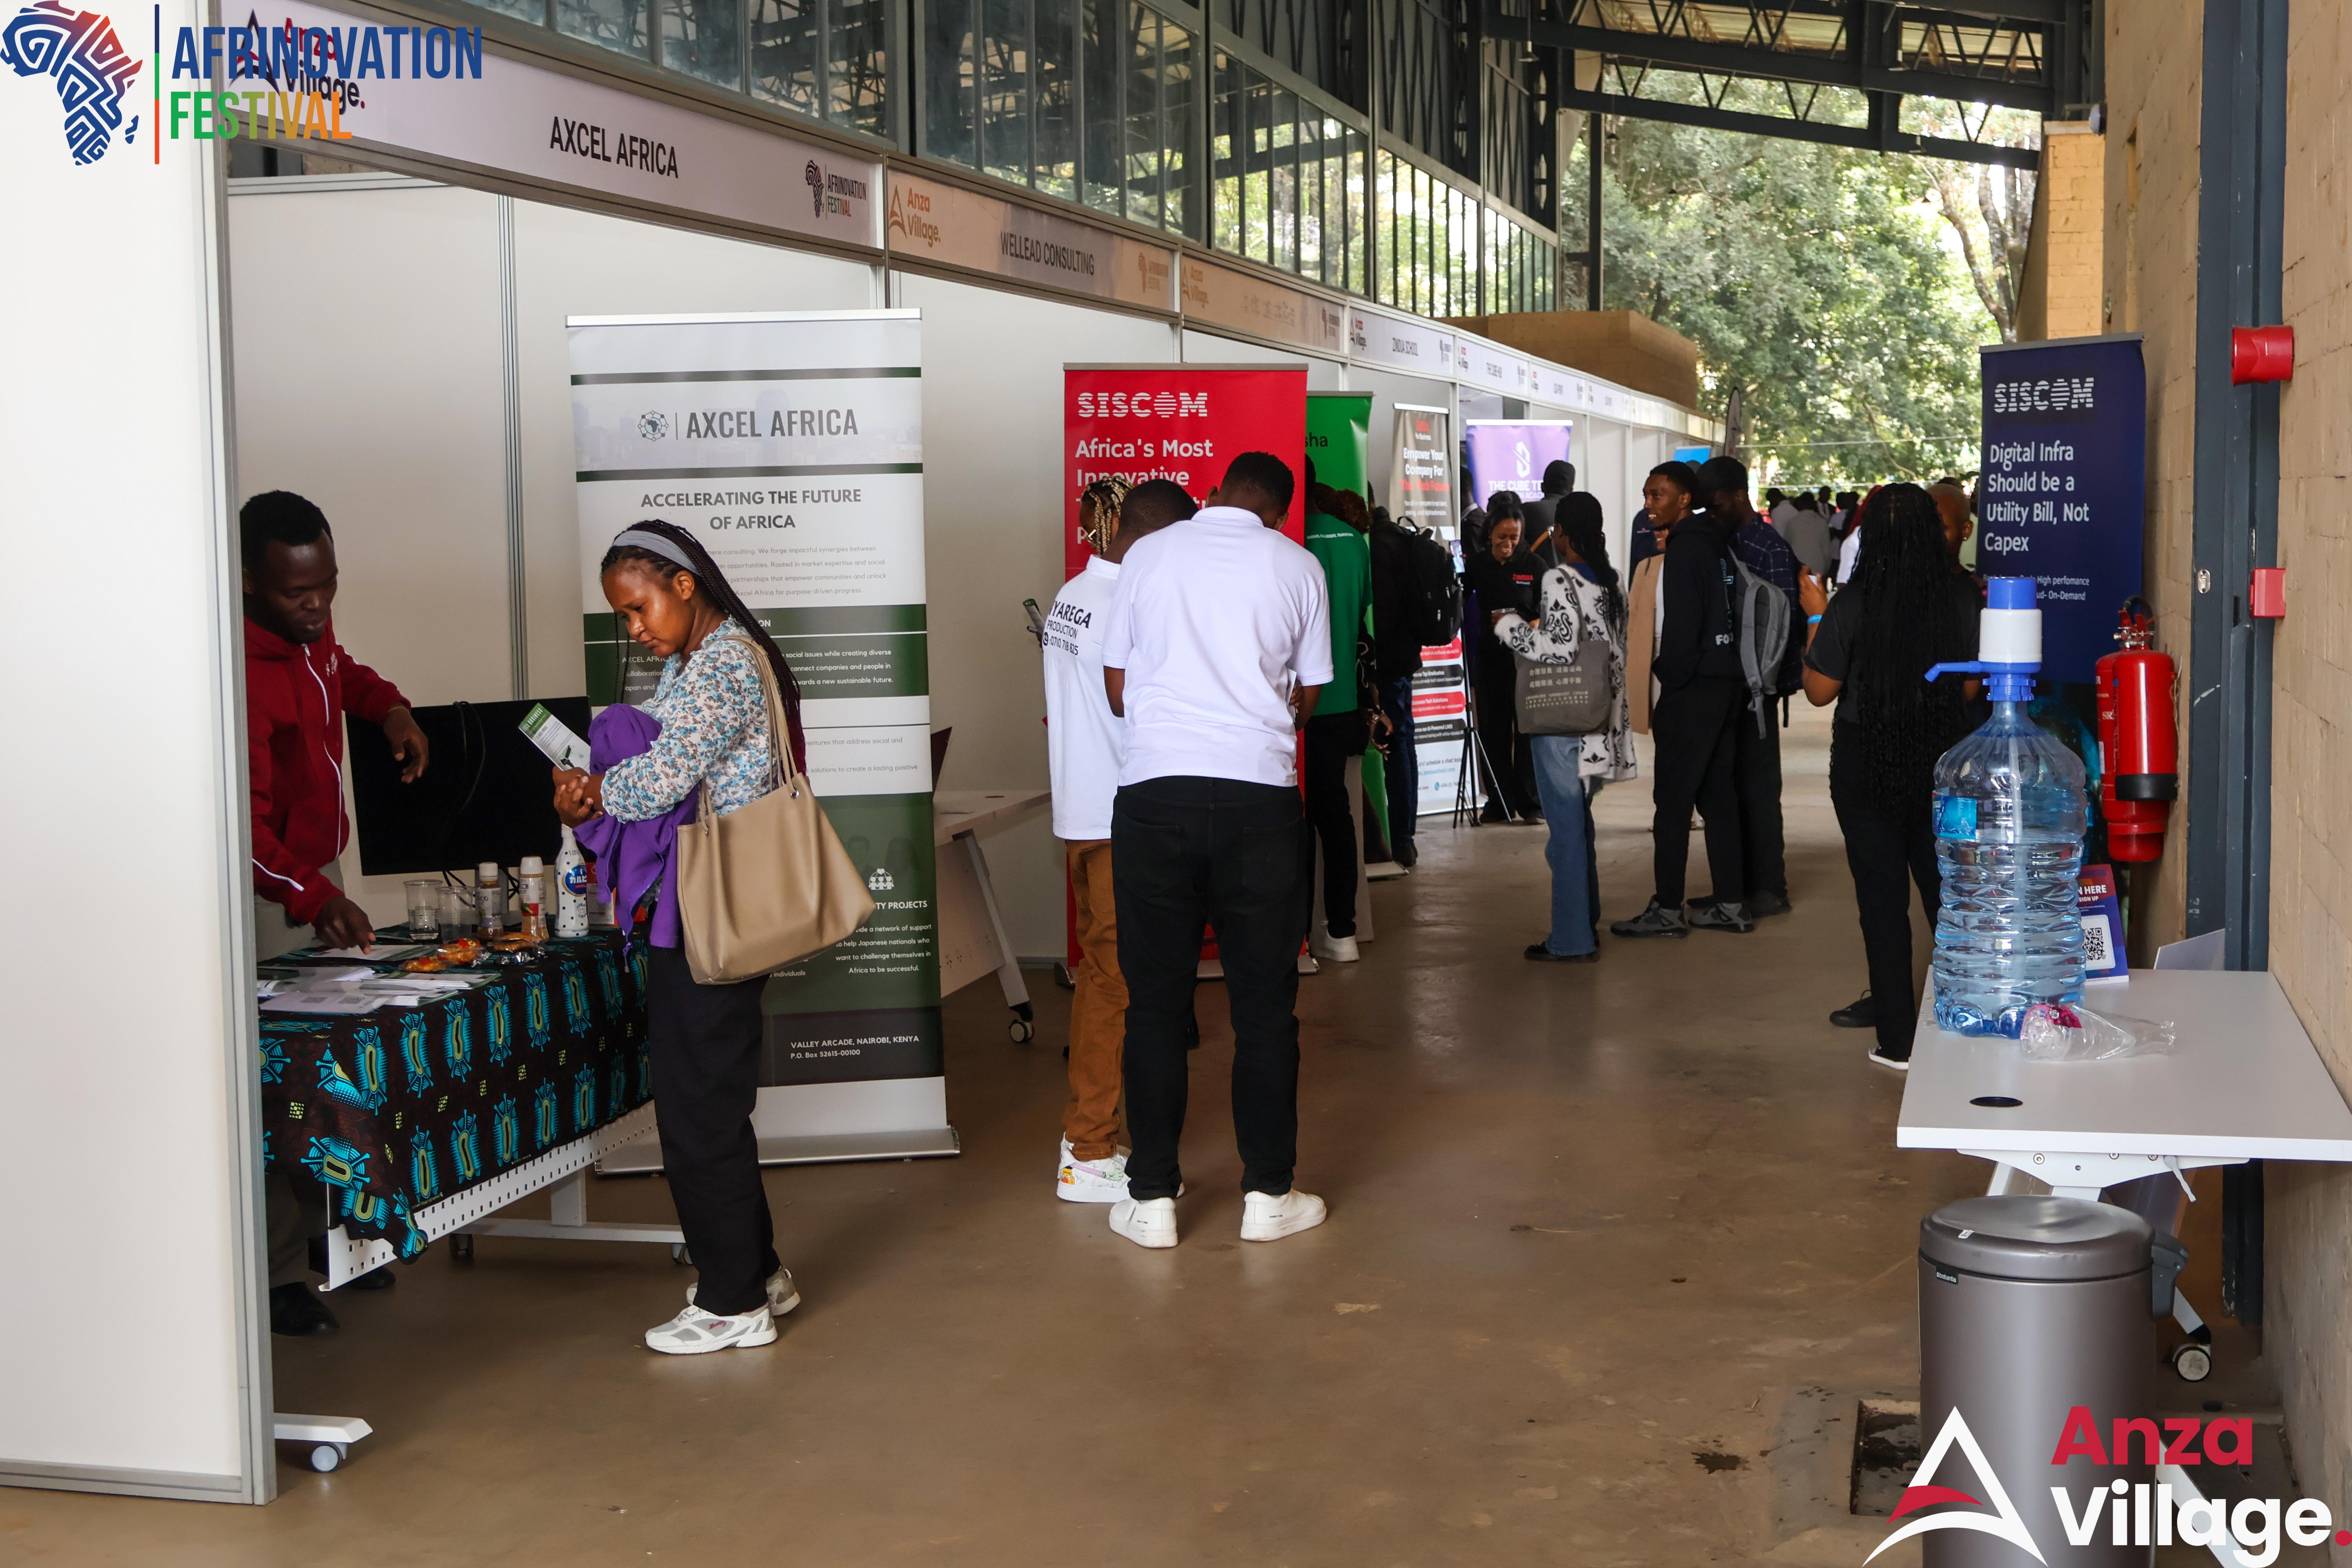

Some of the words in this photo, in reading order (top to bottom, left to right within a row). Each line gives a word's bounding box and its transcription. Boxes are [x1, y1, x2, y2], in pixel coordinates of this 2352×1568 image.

[550, 116, 611, 162] AXCEL
[616, 133, 679, 179] AFRICA
[828, 174, 866, 201] AFRINOVATION
[828, 195, 851, 217] FESTIVAL
[907, 187, 930, 213] Anza
[907, 213, 941, 248] Village.
[1000, 231, 1042, 263] WELLEAD
[1044, 242, 1094, 276] CONSULTING
[1078, 392, 1208, 418] SISCOM
[1994, 377, 2094, 413] SISCOM
[686, 411, 762, 439] AXCEL
[770, 408, 858, 437] AFRICA
[1076, 438, 1154, 458] Africa's
[1163, 439, 1214, 457] Most
[1403, 447, 1430, 462] Empower
[1430, 449, 1444, 460] Your
[1990, 441, 2035, 471] Digital
[2040, 440, 2074, 462] Infra
[1405, 464, 1432, 479] Company
[1433, 465, 1443, 476] For
[1988, 471, 2036, 493] Should
[2042, 471, 2060, 492] be
[2065, 475, 2075, 491] a
[1488, 480, 1506, 490] THE
[1508, 480, 1530, 491] CUBE
[1531, 480, 1544, 491] TE
[641, 490, 764, 507] ACCELERATING
[768, 490, 797, 505] THE
[802, 488, 861, 503] FUTURE
[710, 515, 732, 530] OF
[735, 514, 796, 529] AFRICA
[1987, 501, 2029, 526] Utility
[2033, 502, 2058, 526] Bill,
[2063, 502, 2089, 523] Not
[1985, 532, 2029, 556] Capex
[730, 575, 769, 584] partnerships
[2048, 590, 2086, 601] On-Demand
[1047, 620, 1078, 639] PRODUCTION
[2084, 885, 2107, 895] HERE
[888, 900, 928, 909] PROJECTS
[822, 1039, 855, 1047] ARCADE,
[857, 1037, 891, 1045] NAIROBI,
